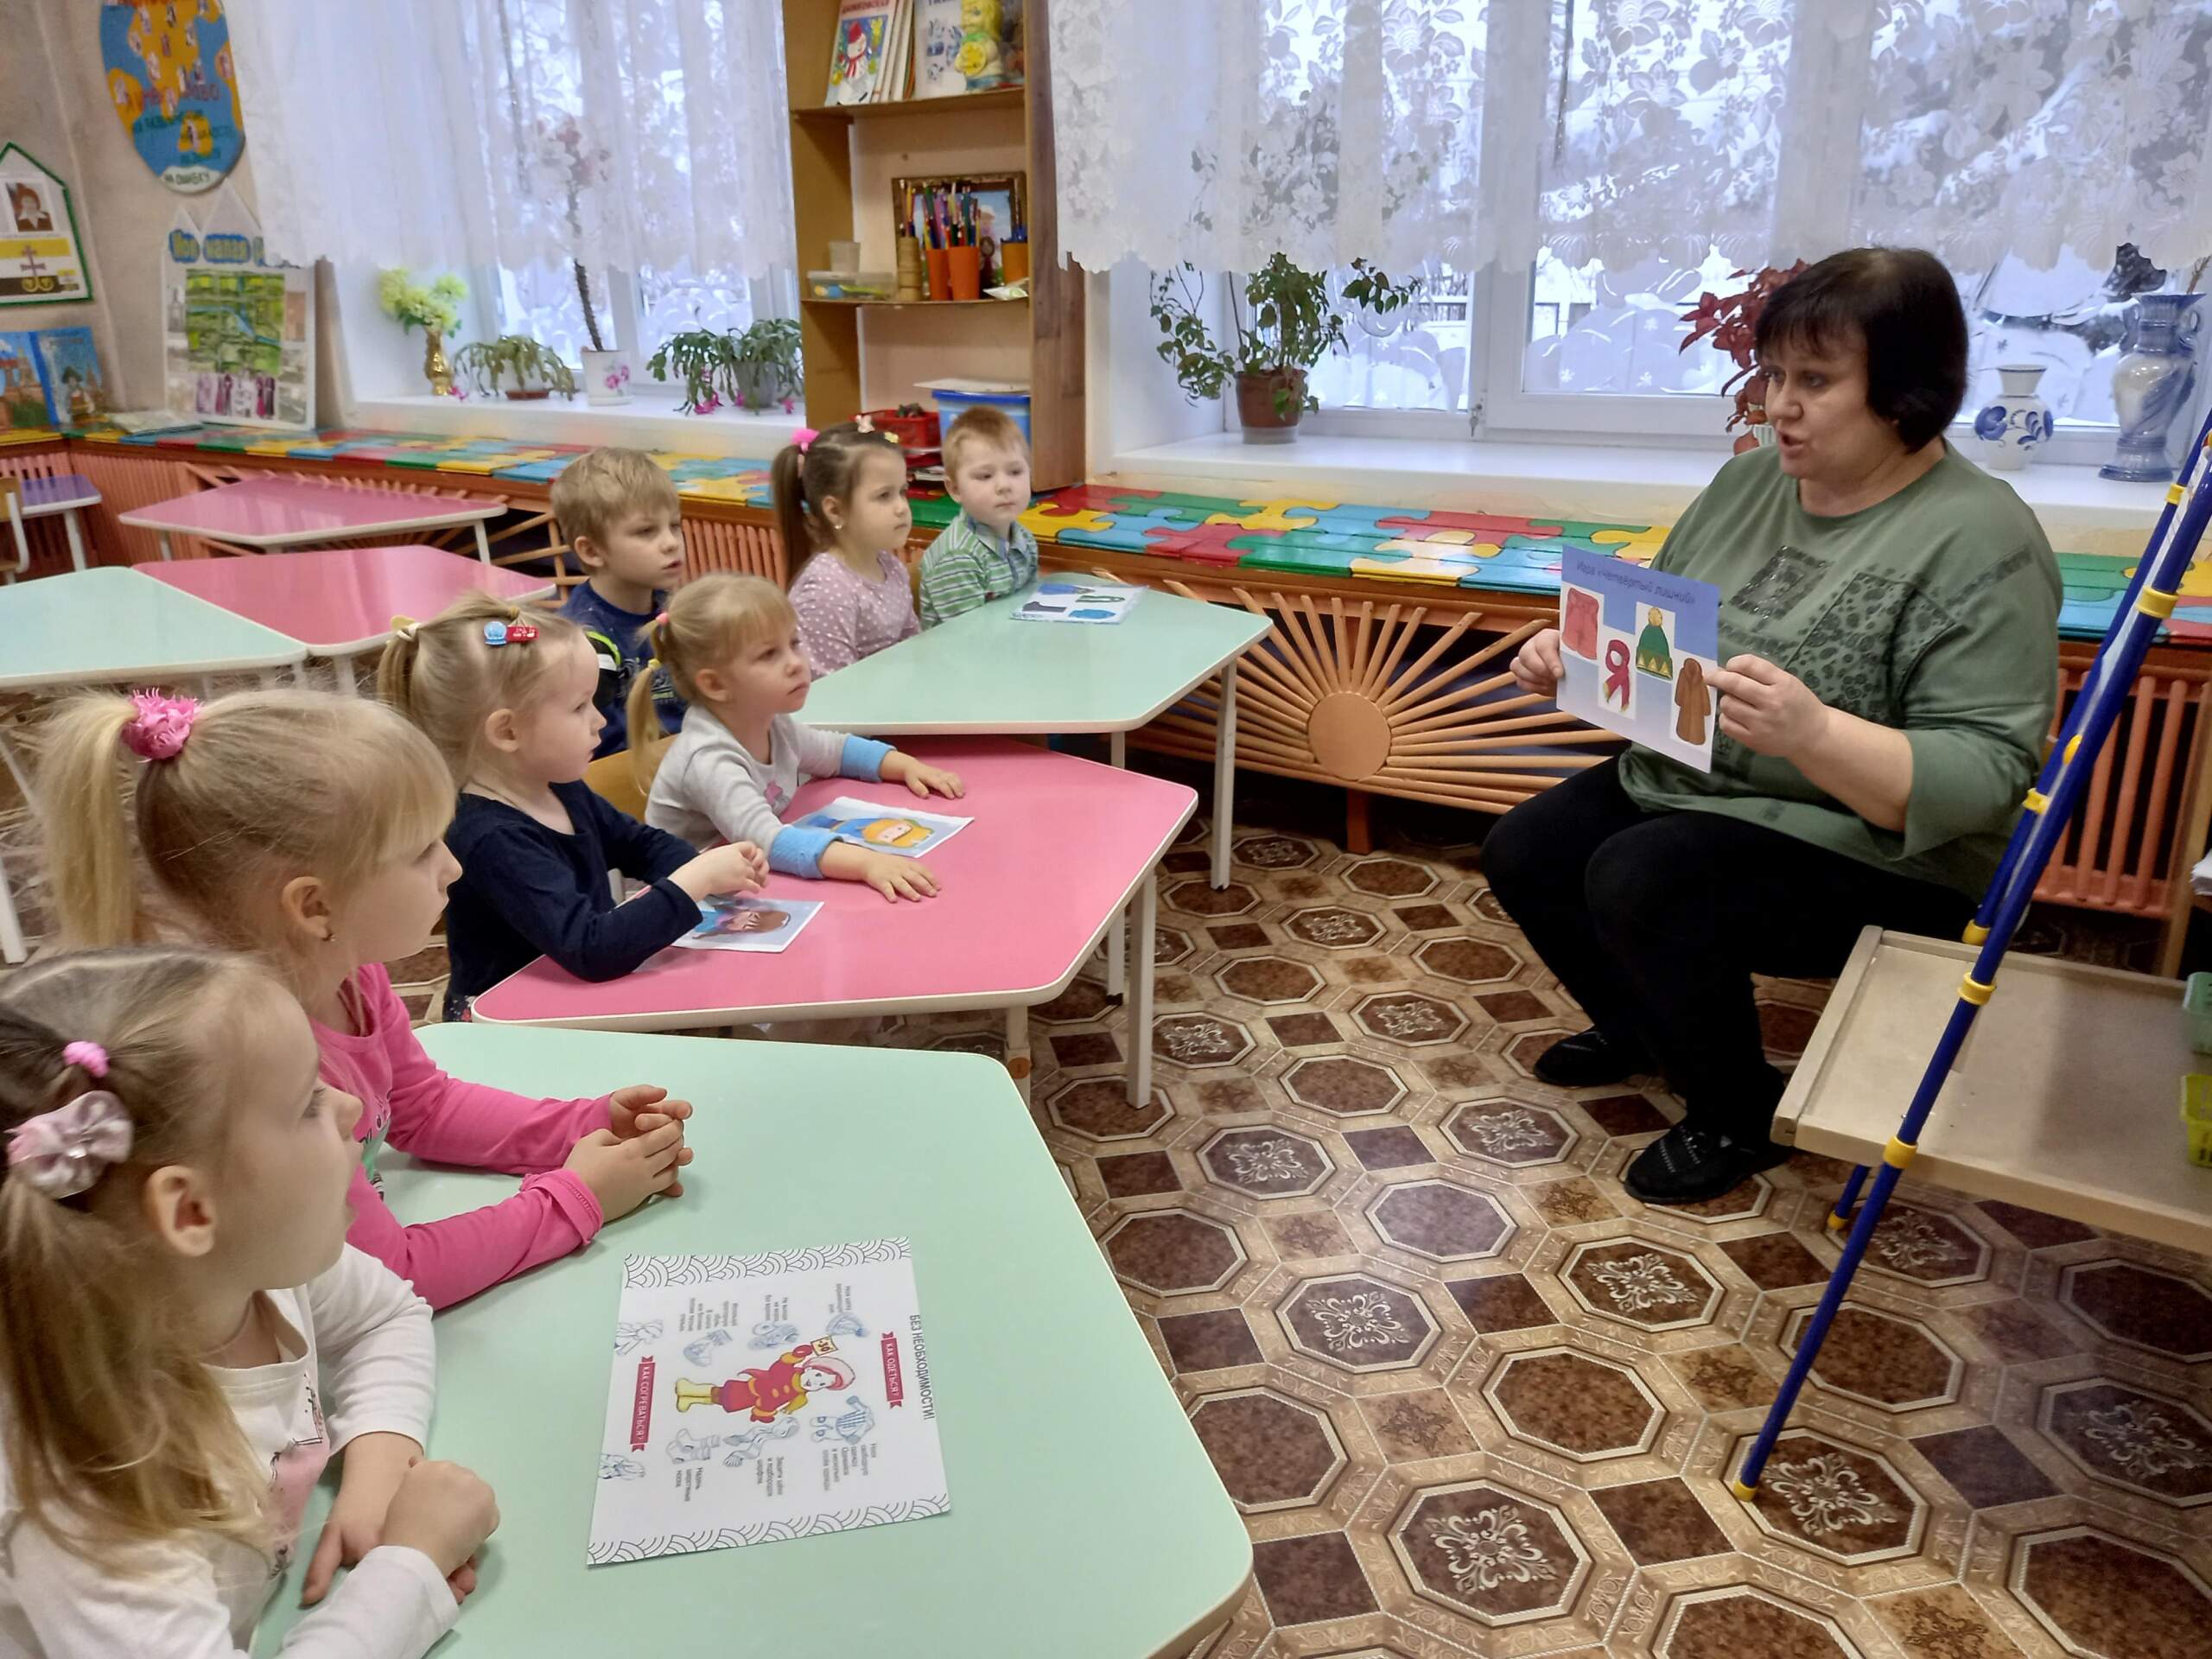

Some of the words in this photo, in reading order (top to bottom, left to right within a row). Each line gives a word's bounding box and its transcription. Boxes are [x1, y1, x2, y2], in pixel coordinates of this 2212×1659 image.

[910, 1314, 922, 1331] БЕЗ
[885, 1342, 893, 1357] КАК
[642, 1366, 651, 1380] КАК
[887, 1358, 899, 1396] ОДЕТЬСЯ?
[912, 1332, 935, 1420] НЕОБХОДИМОСТИ!
[636, 1382, 650, 1439] СОГРЕВАТЬСЯ?
